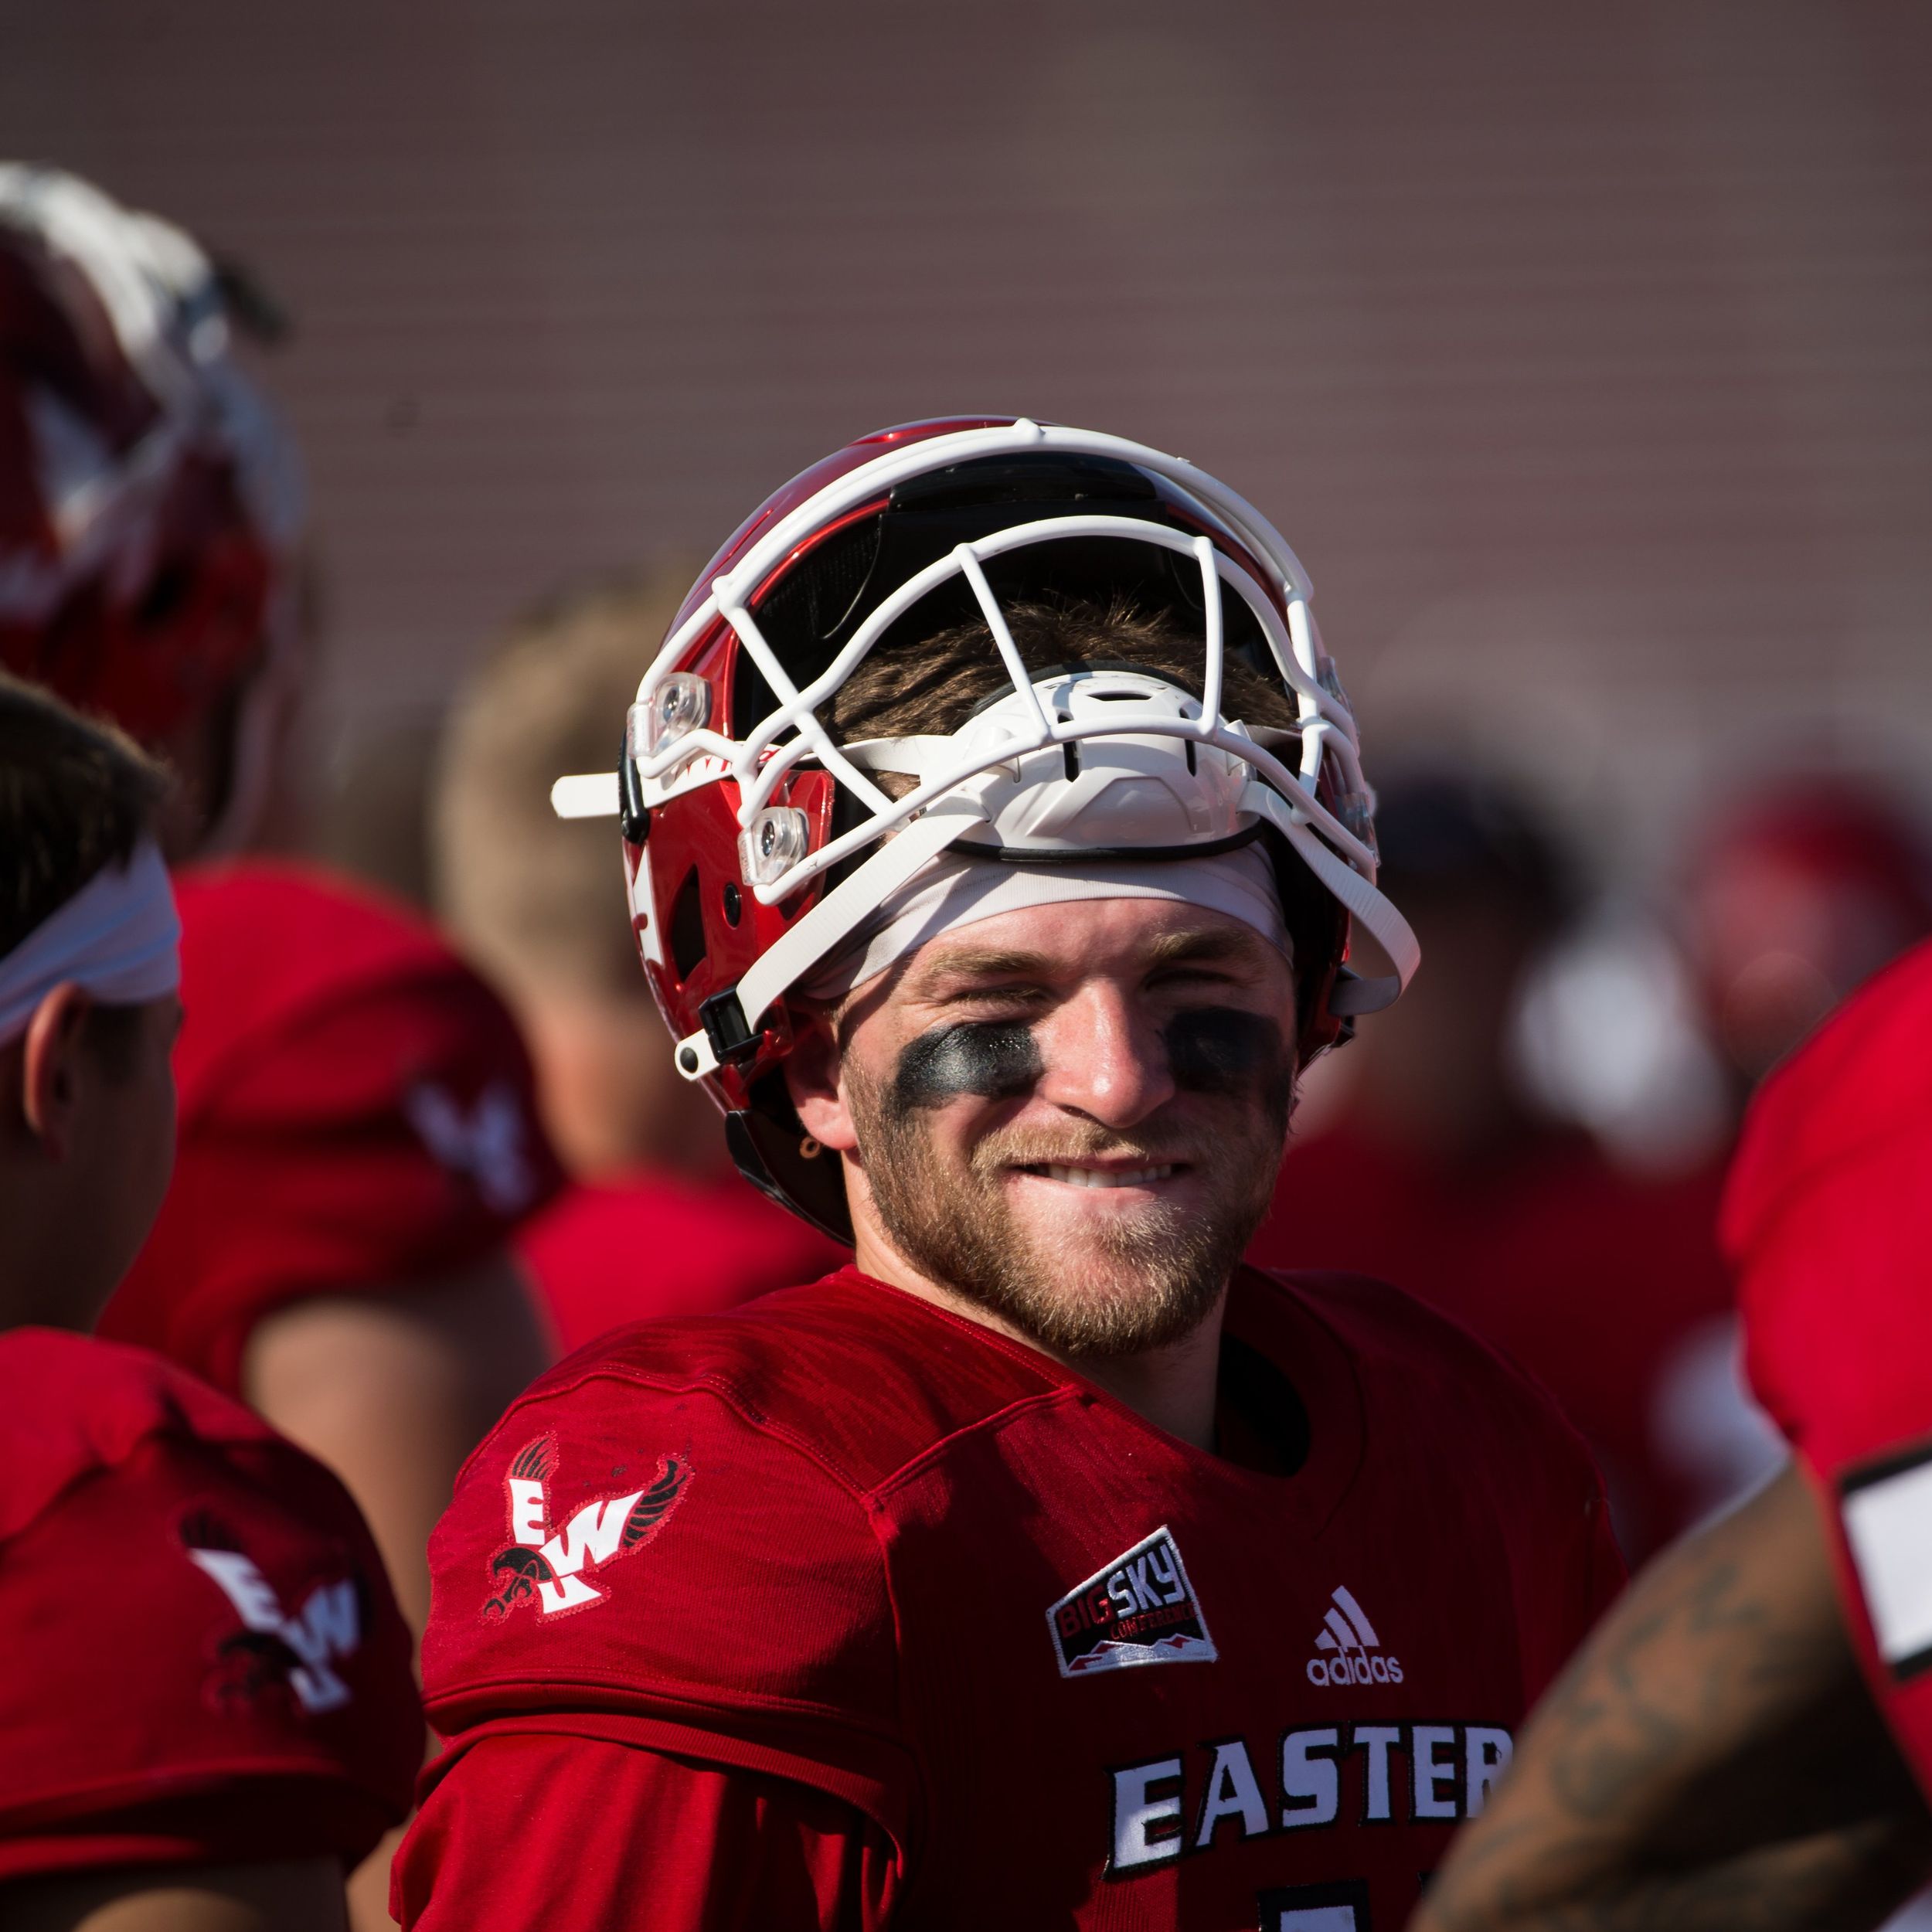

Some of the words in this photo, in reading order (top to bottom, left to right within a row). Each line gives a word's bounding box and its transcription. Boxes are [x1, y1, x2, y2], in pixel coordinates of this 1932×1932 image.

[1056, 1584, 1114, 1638] BIG
[1106, 1544, 1186, 1619] SKY
[1306, 1645, 1404, 1687] adidas
